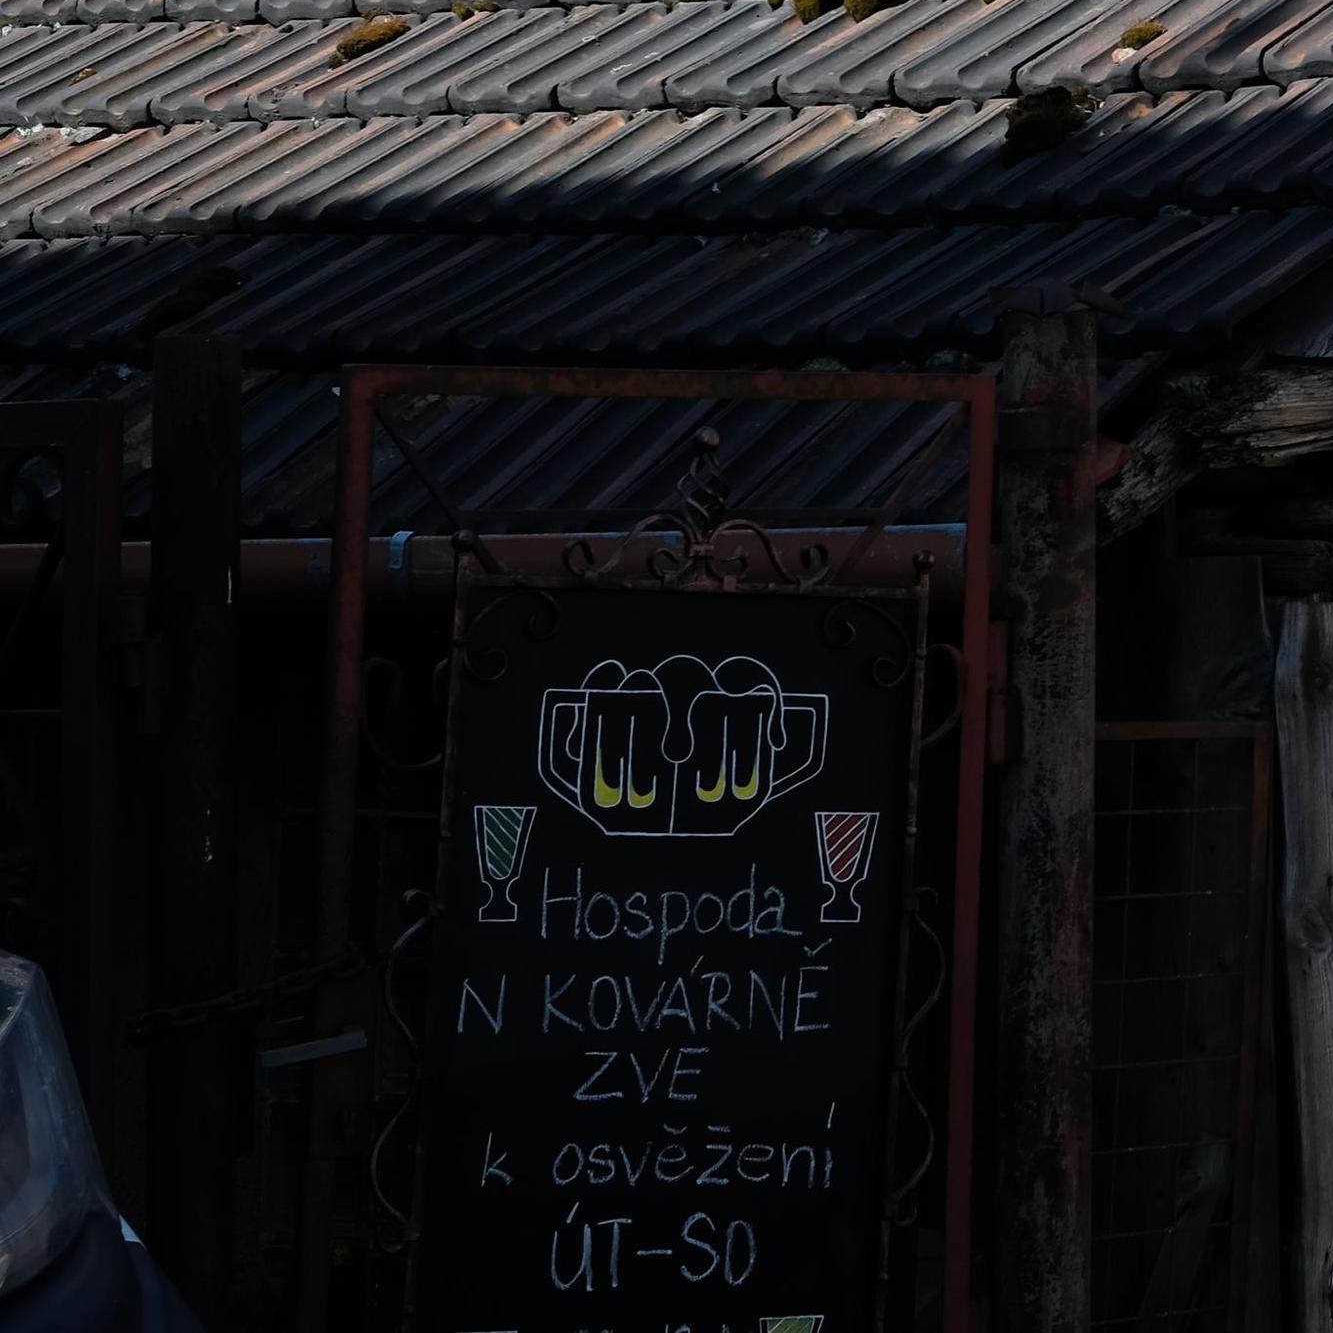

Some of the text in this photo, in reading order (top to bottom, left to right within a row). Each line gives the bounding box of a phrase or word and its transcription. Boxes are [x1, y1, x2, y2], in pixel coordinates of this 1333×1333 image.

[540, 862, 803, 966] Hospoda
[456, 938, 832, 1041] N KOVÁRNĚ
[572, 1047, 710, 1104] ZVE
[480, 1101, 837, 1189] k osvěžení
